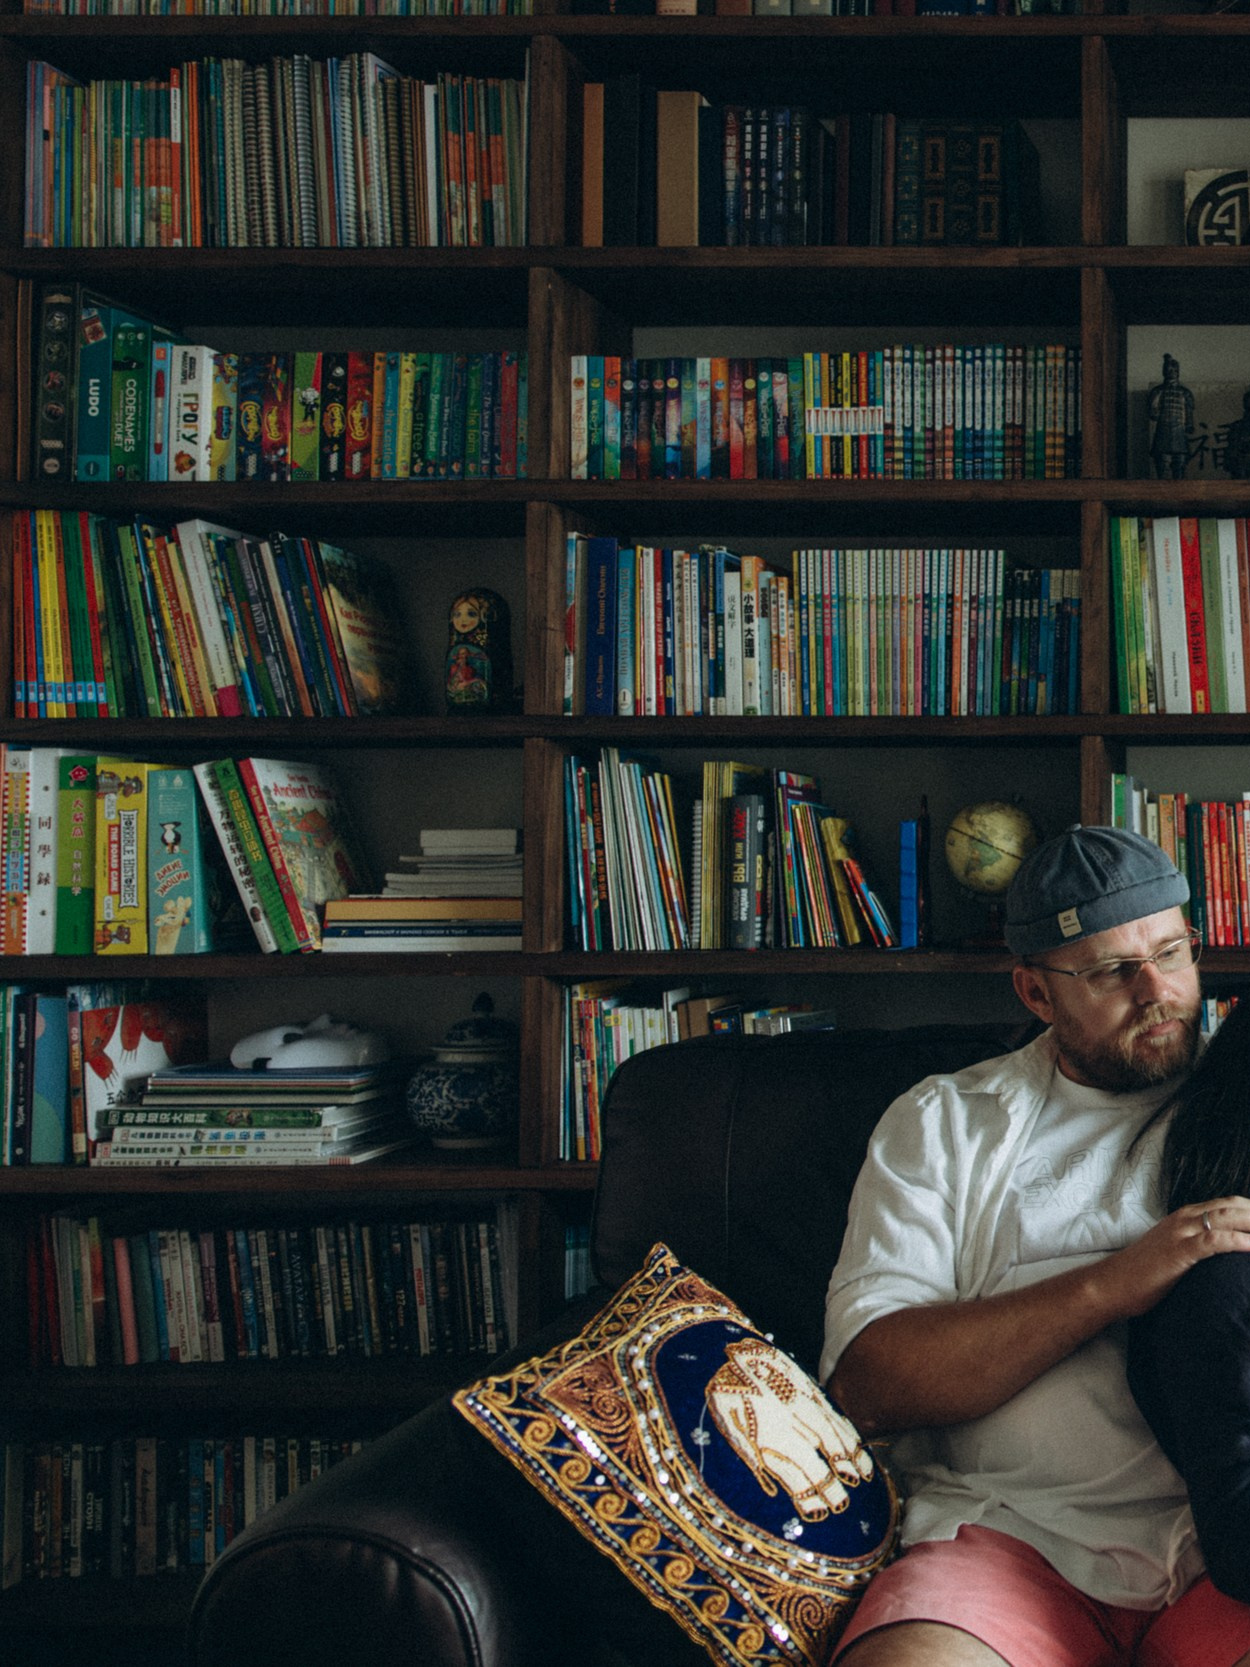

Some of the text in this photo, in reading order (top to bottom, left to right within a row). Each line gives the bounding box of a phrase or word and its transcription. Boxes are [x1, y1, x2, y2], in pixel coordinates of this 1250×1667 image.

[88, 378, 101, 417] LUDO
[124, 378, 137, 453] CODENAMES
[182, 393, 199, 445] ГРОГУ
[114, 423, 124, 447] DUET
[744, 593, 756, 624] 小故事
[272, 782, 306, 797] Ancient
[110, 826, 118, 893] THE BOARD GAME
[123, 813, 135, 903] HORRIBLE HISTORIES
[735, 842, 743, 859] ИЛИ
[154, 858, 182, 881] ДИКИЕ
[156, 870, 191, 898] ЭМОЦИИ
[732, 863, 745, 883] ВЫ
[71, 1027, 81, 1071] GO WILD!
